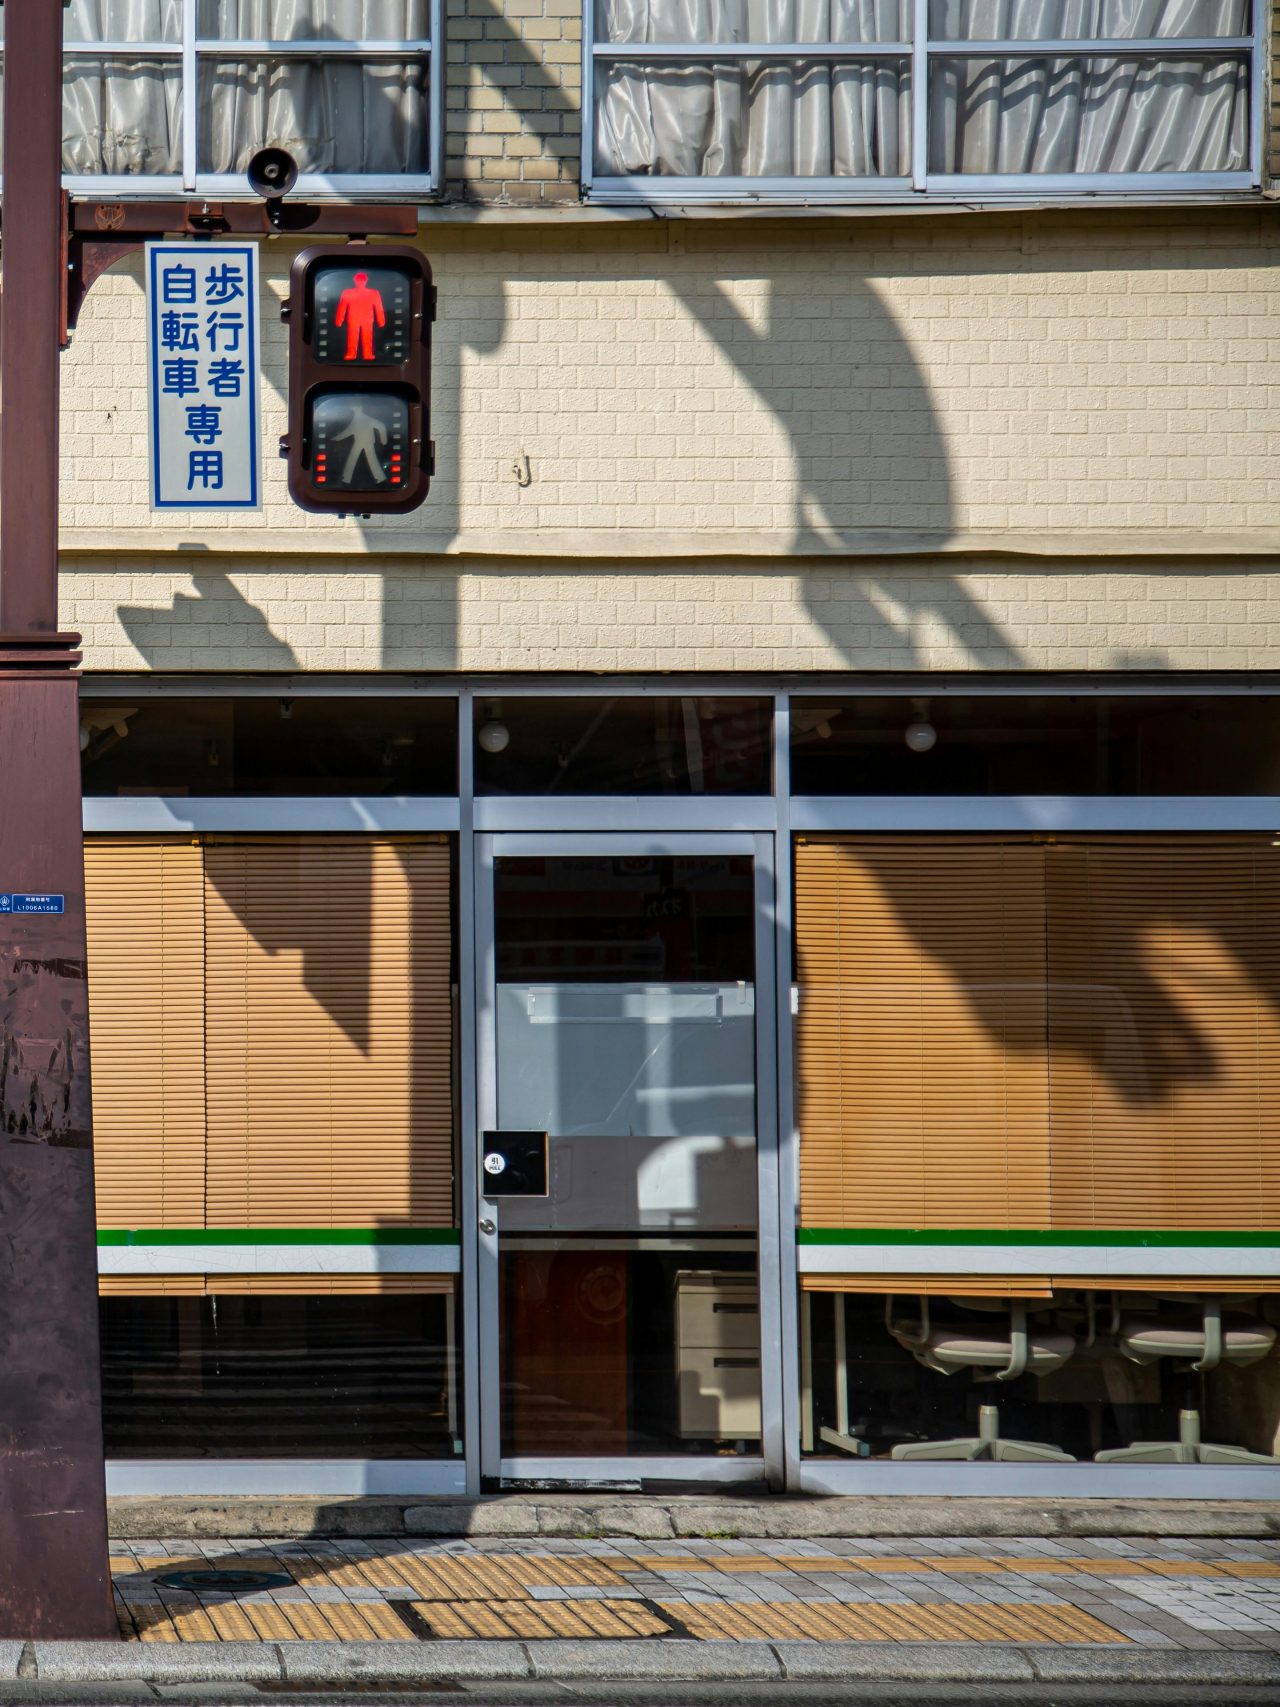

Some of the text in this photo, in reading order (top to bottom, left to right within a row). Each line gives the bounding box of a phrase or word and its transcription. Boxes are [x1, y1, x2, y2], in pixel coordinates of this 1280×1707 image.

[161, 264, 201, 399] 自転車
[205, 263, 245, 398] 歩行者
[185, 404, 224, 491] 専用
